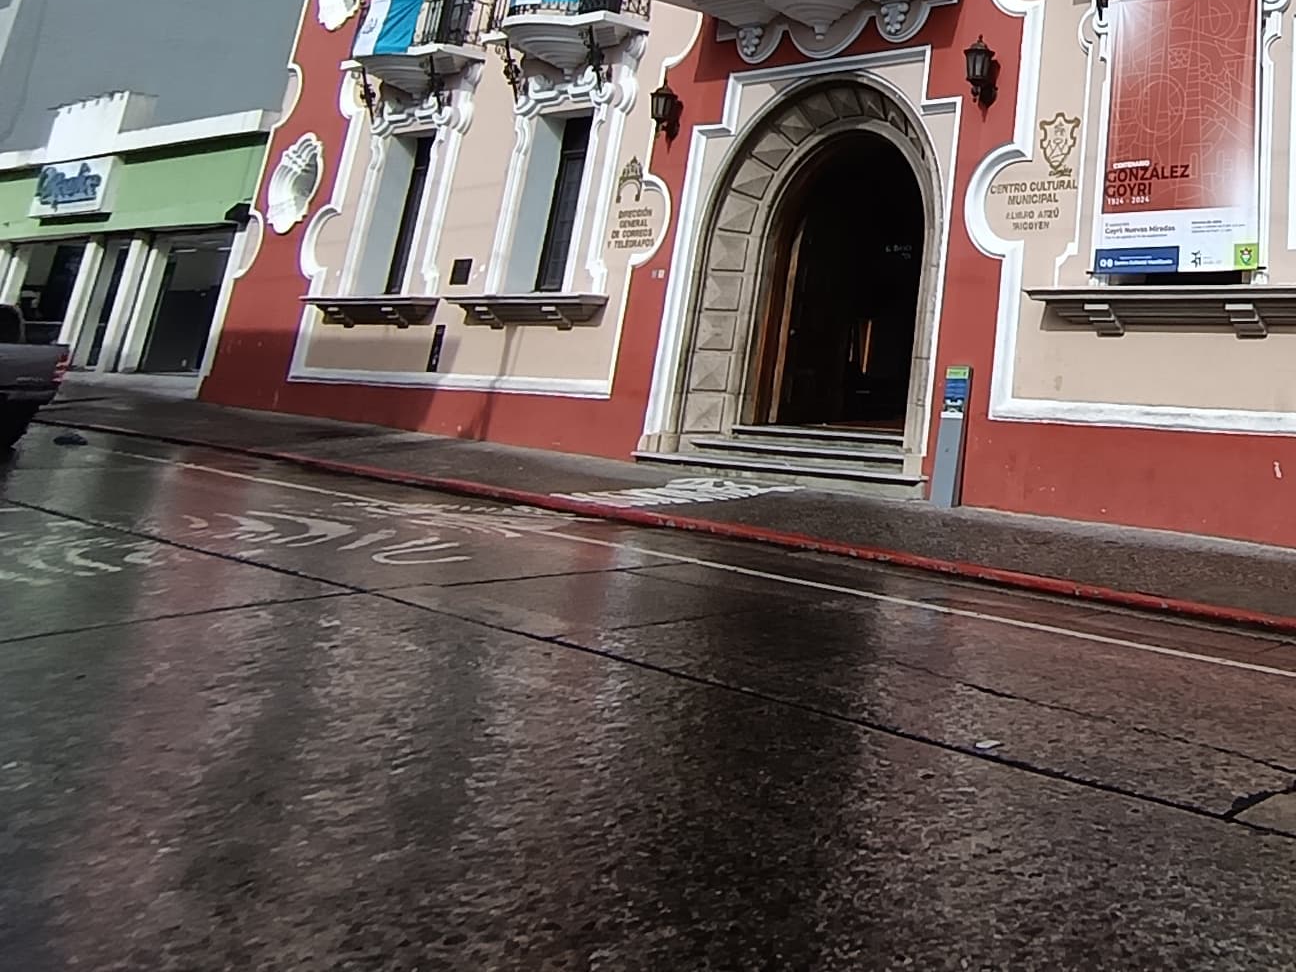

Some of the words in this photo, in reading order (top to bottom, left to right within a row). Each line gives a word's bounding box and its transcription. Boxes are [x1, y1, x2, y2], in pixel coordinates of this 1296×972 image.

[1107, 163, 1190, 183] GONZÁLEZ
[990, 183, 1027, 194] CENTRO
[1029, 180, 1078, 192] CULTURAL
[1105, 182, 1152, 198] GOYRI
[1007, 193, 1059, 205] MUNICIPAL
[1107, 197, 1124, 205] 1924
[1131, 195, 1150, 204] 2024
[618, 207, 653, 219] DIRECCIÓN
[619, 219, 648, 228] GENERAL
[611, 230, 620, 239] DE
[622, 228, 652, 238] CORREOS
[614, 238, 654, 248] TELÉGRAFOS
